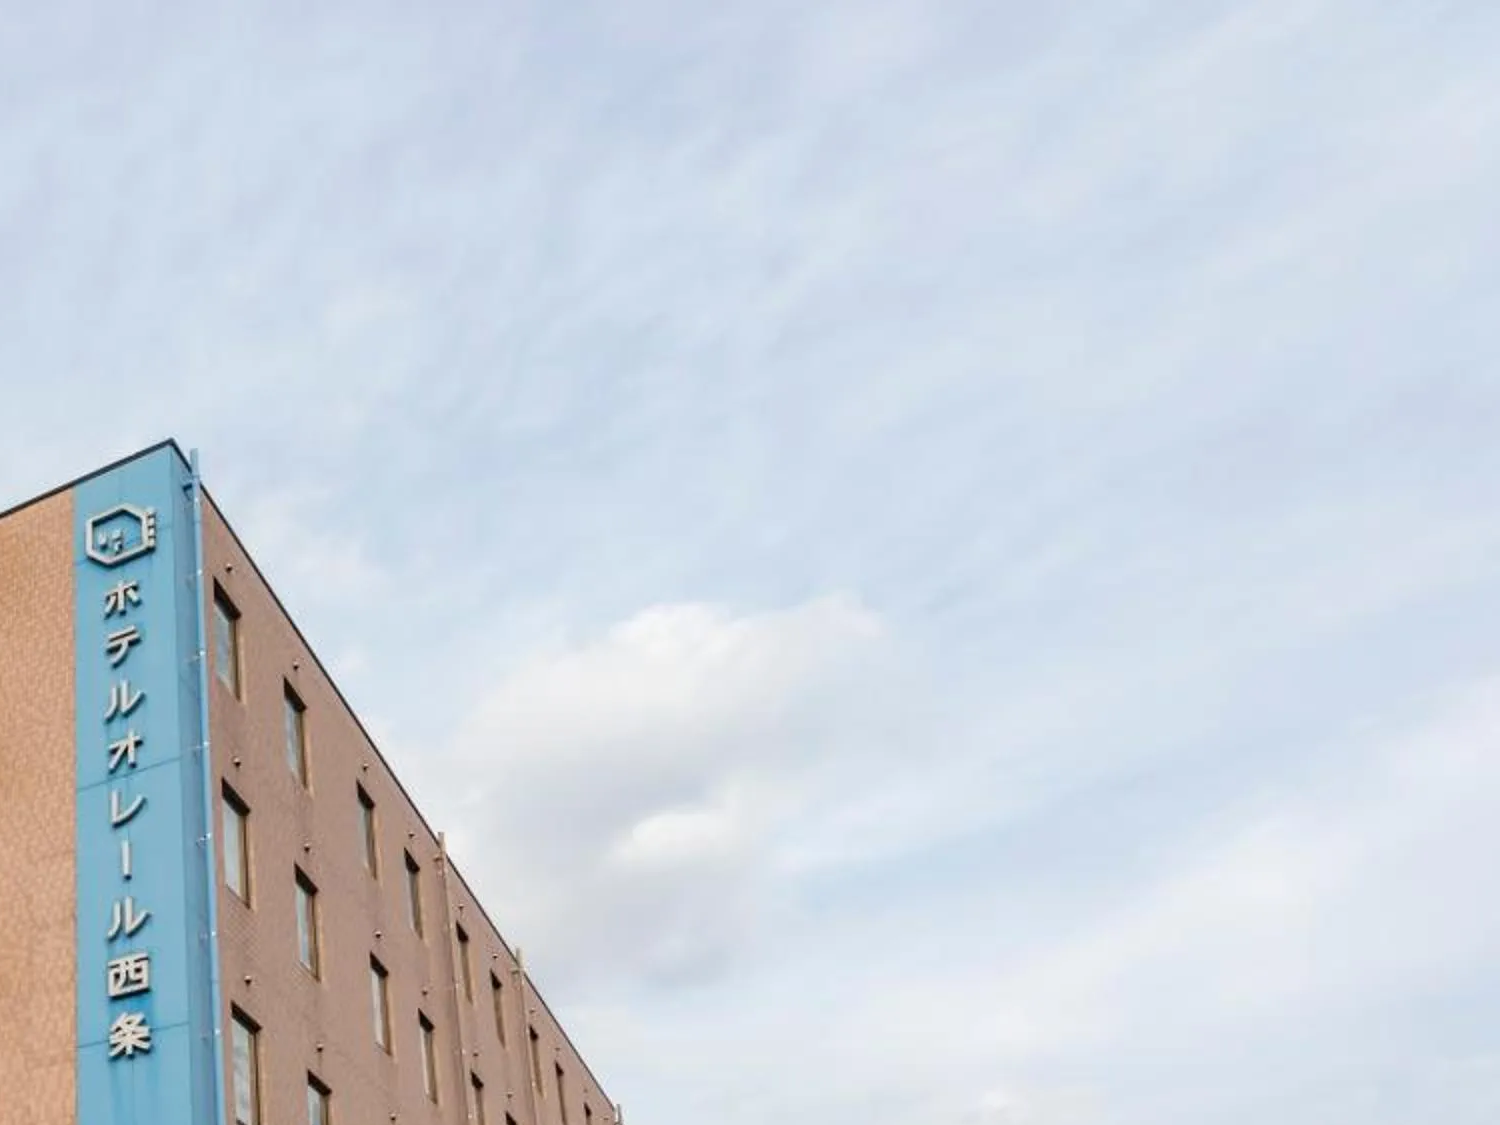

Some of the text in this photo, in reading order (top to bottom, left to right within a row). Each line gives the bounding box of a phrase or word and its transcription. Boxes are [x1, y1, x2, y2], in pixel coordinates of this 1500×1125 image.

[104, 579, 152, 1060] ホテルオレール西条
